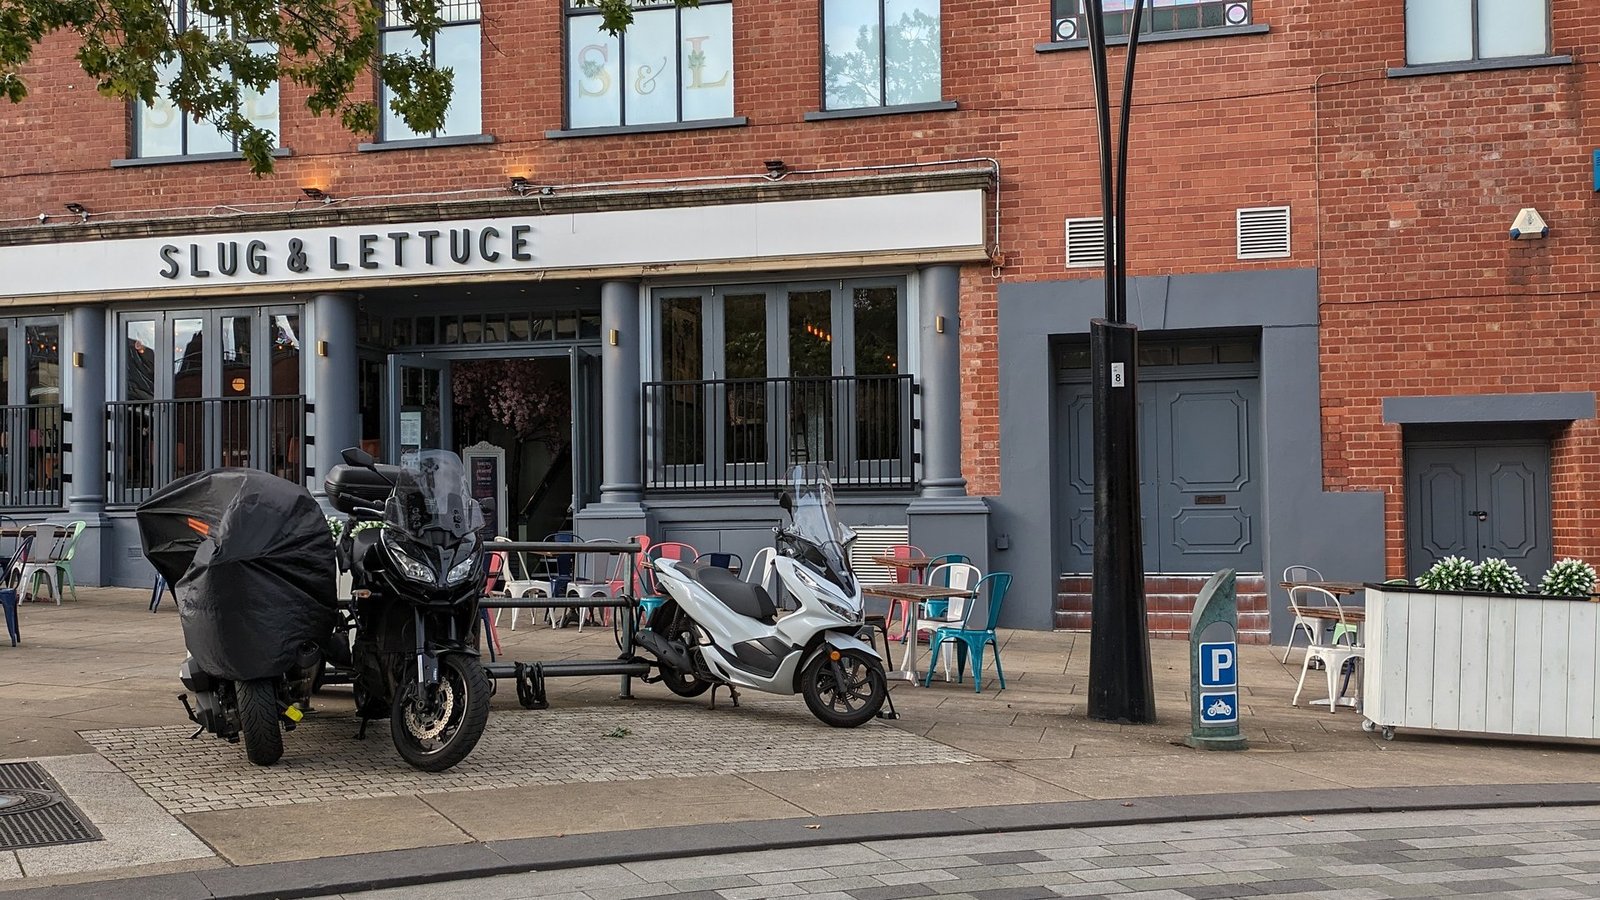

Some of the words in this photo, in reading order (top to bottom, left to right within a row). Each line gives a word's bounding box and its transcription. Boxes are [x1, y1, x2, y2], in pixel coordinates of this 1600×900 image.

[577, 43, 611, 98] S
[634, 56, 668, 96] &
[686, 35, 729, 90] L
[160, 240, 268, 279] SLUG
[287, 237, 309, 273] &
[329, 225, 532, 271] LETTUCE
[1115, 373, 1121, 382] 8
[1211, 648, 1233, 682] P
